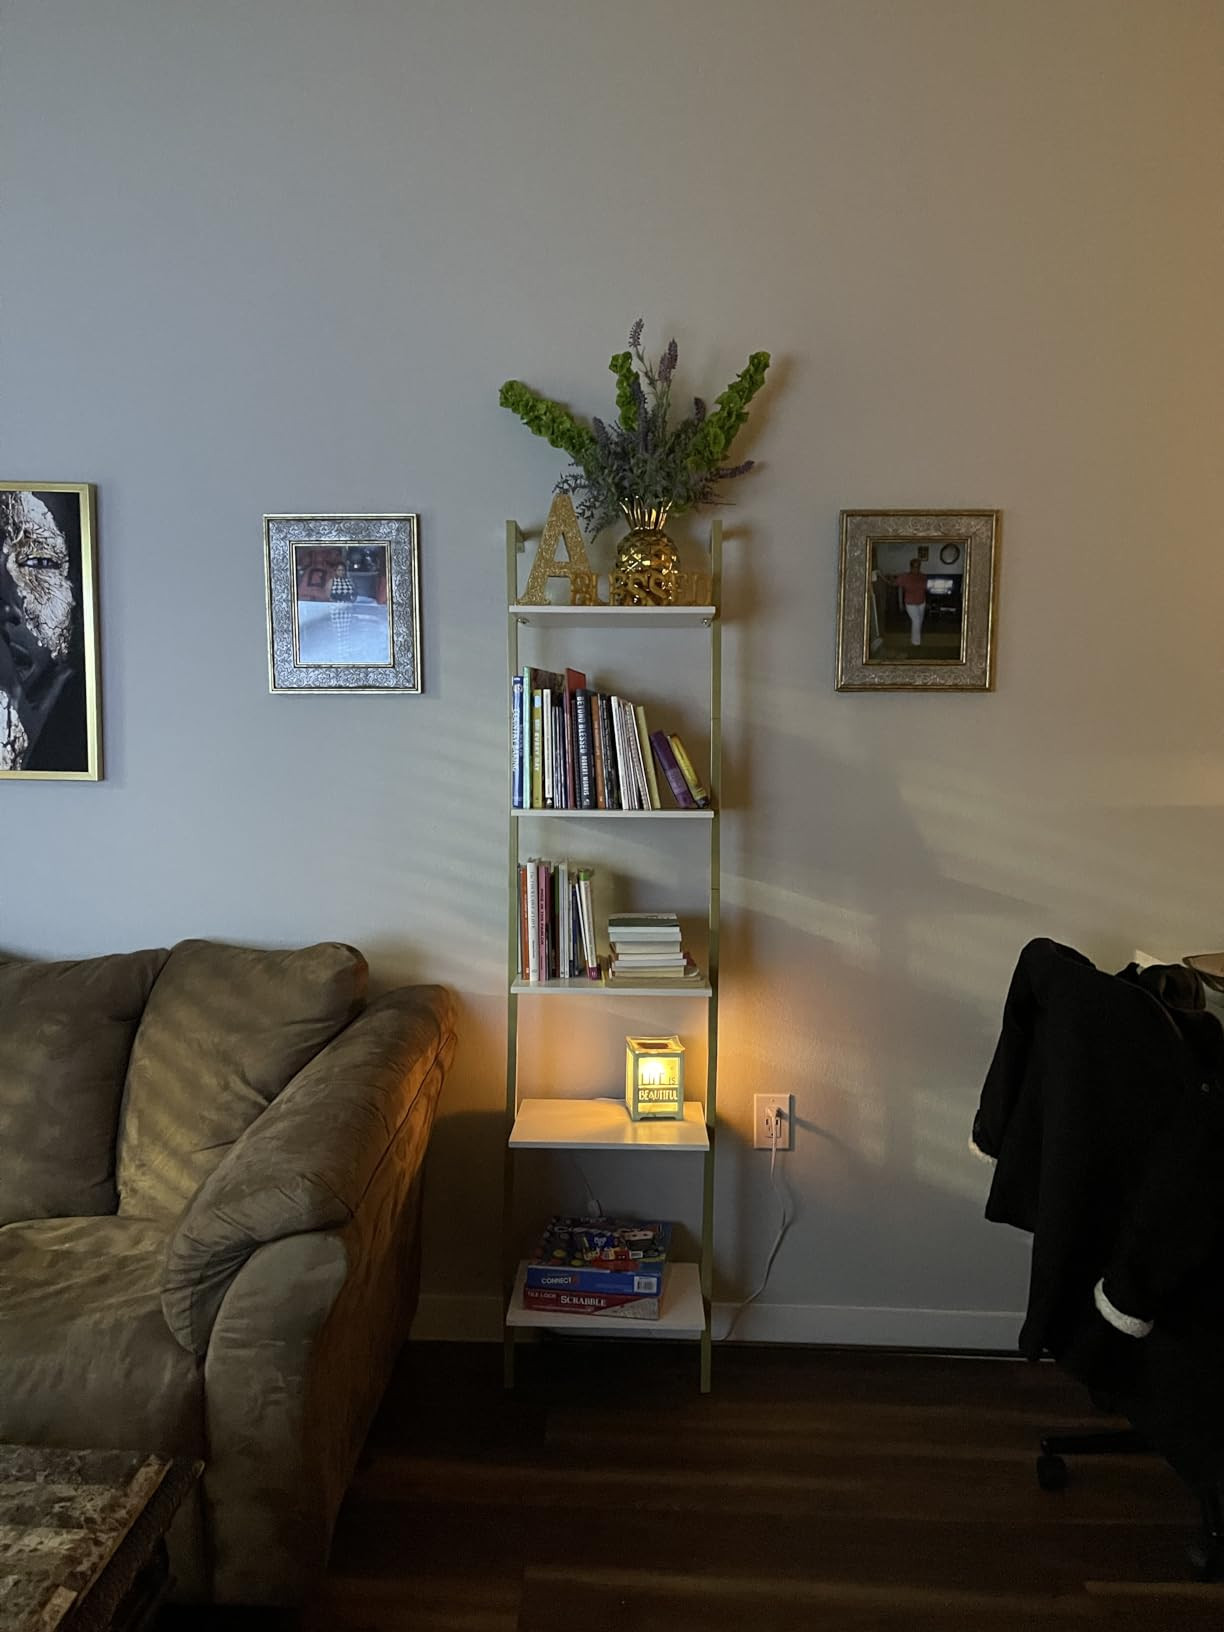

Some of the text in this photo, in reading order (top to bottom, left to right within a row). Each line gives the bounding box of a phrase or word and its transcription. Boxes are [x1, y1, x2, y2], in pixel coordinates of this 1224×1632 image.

[515, 493, 592, 605] A
[577, 696, 586, 723] BEYOND
[579, 724, 588, 754] BLESSED
[581, 755, 589, 775] ROBERT
[638, 1089, 678, 1101] BEAUTIFUL
[541, 1277, 572, 1285] CONNECT
[560, 1295, 607, 1307] SCRABBLE
